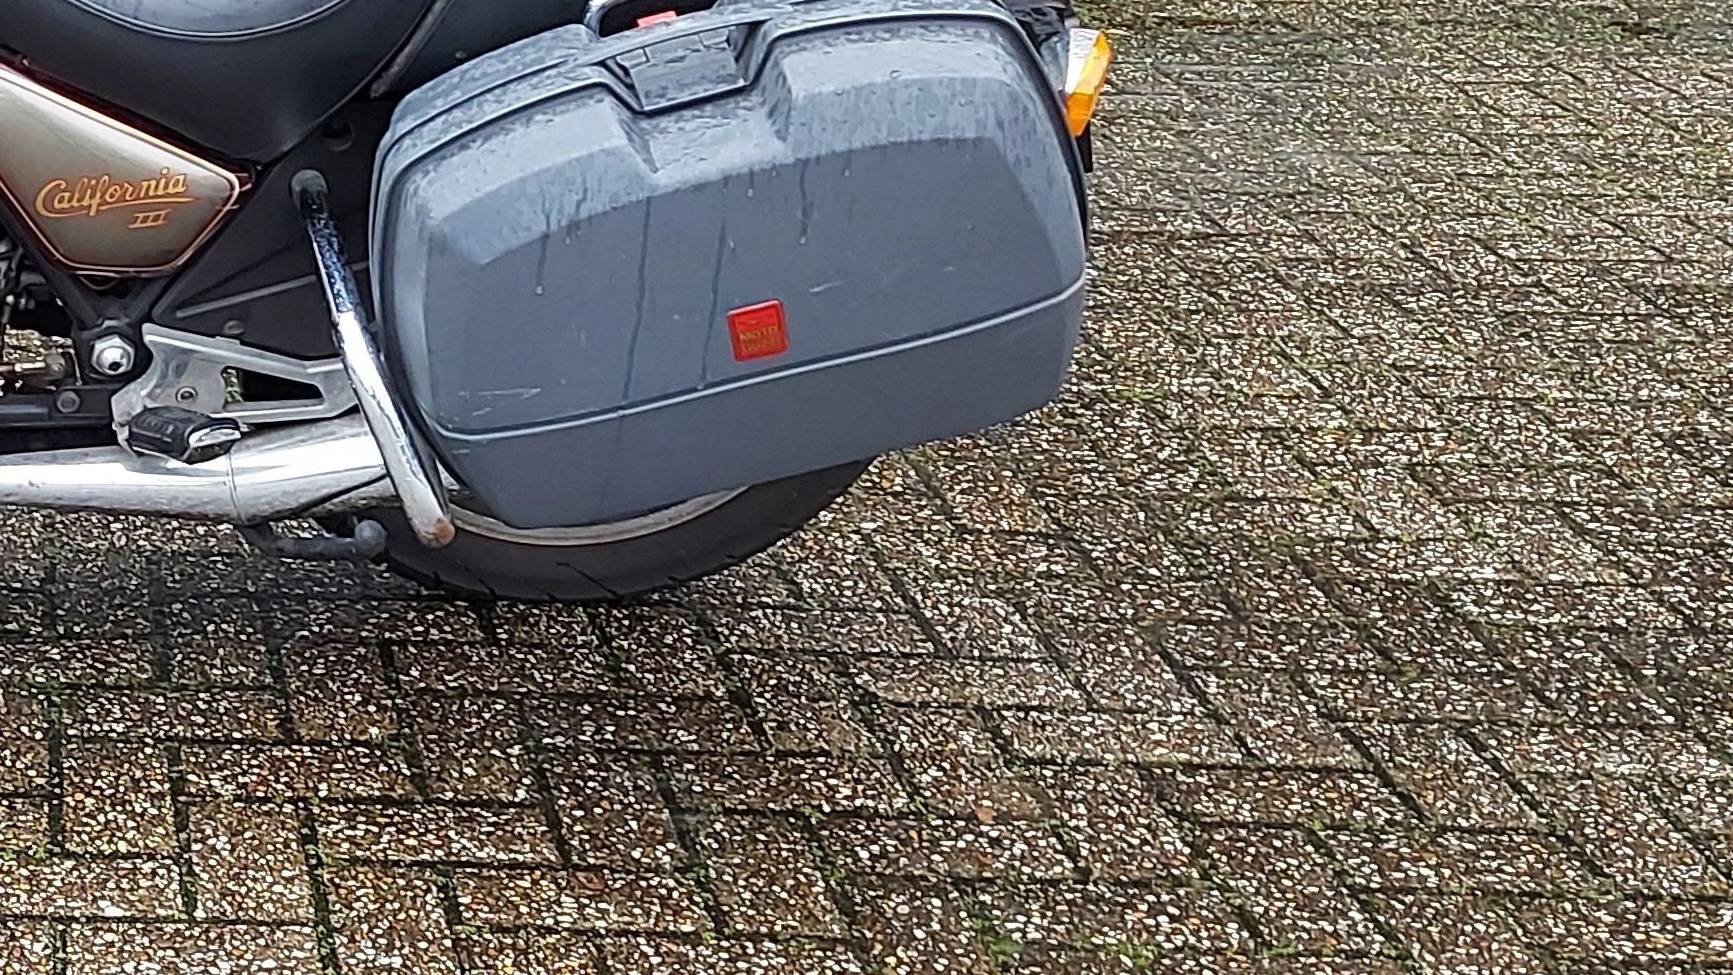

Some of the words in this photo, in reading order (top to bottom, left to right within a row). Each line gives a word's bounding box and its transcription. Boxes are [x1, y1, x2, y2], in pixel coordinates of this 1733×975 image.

[35, 167, 195, 218] California
[127, 208, 173, 229] III
[739, 326, 778, 341] MOTO
